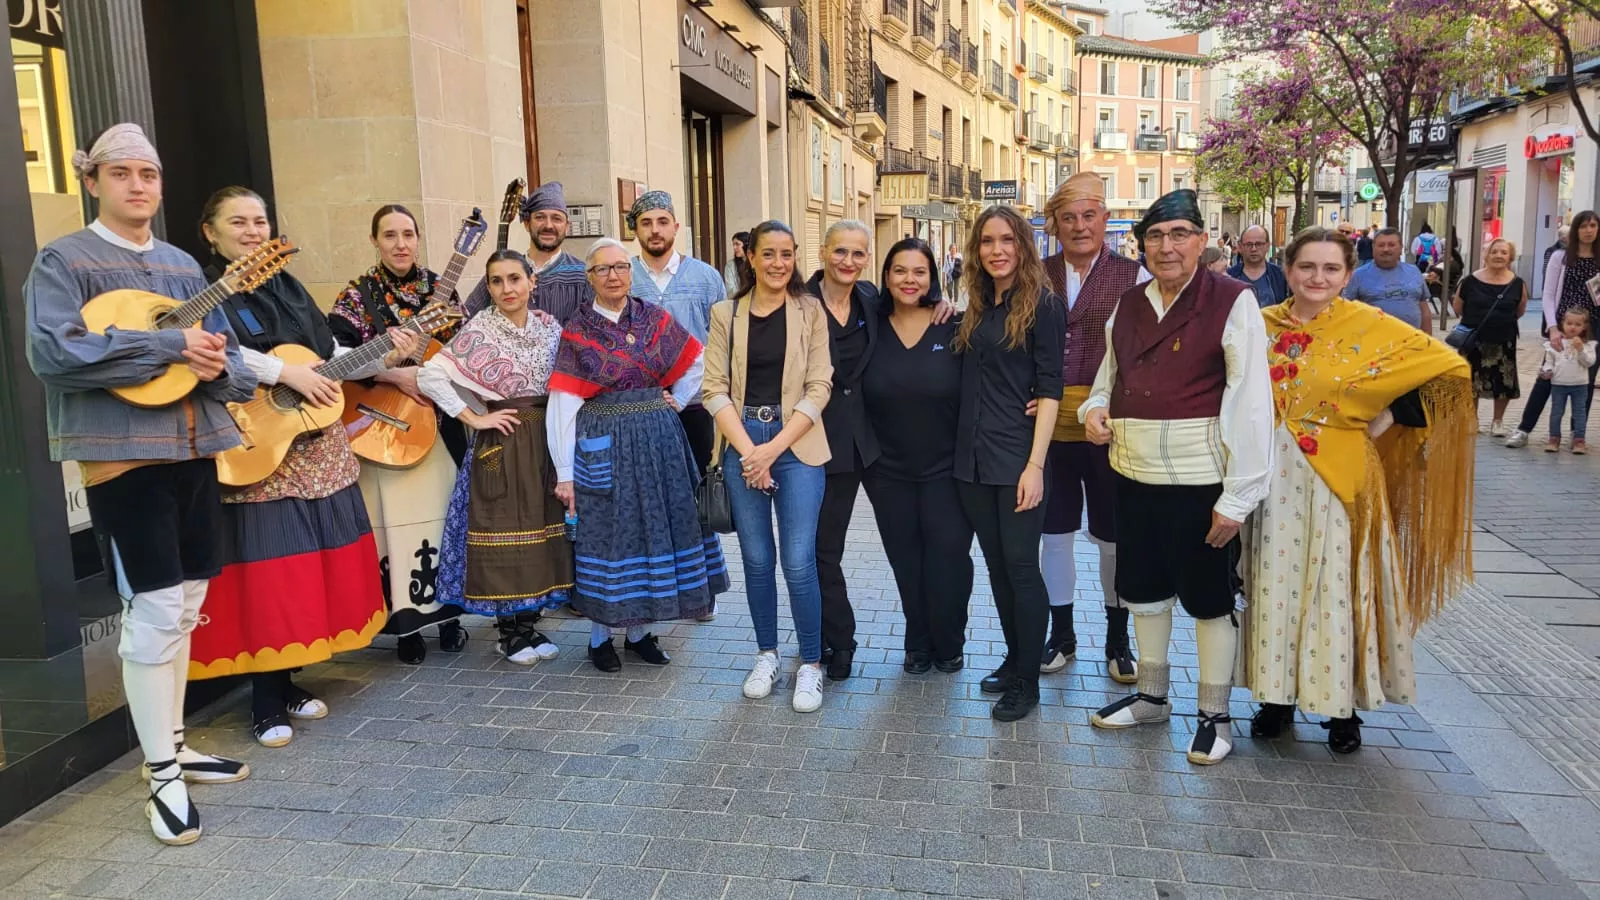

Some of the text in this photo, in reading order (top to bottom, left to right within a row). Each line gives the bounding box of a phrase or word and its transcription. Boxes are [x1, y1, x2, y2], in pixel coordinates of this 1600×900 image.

[683, 13, 707, 57] CMC
[1535, 134, 1572, 153] vodafone
[986, 186, 1015, 194] Arenas
